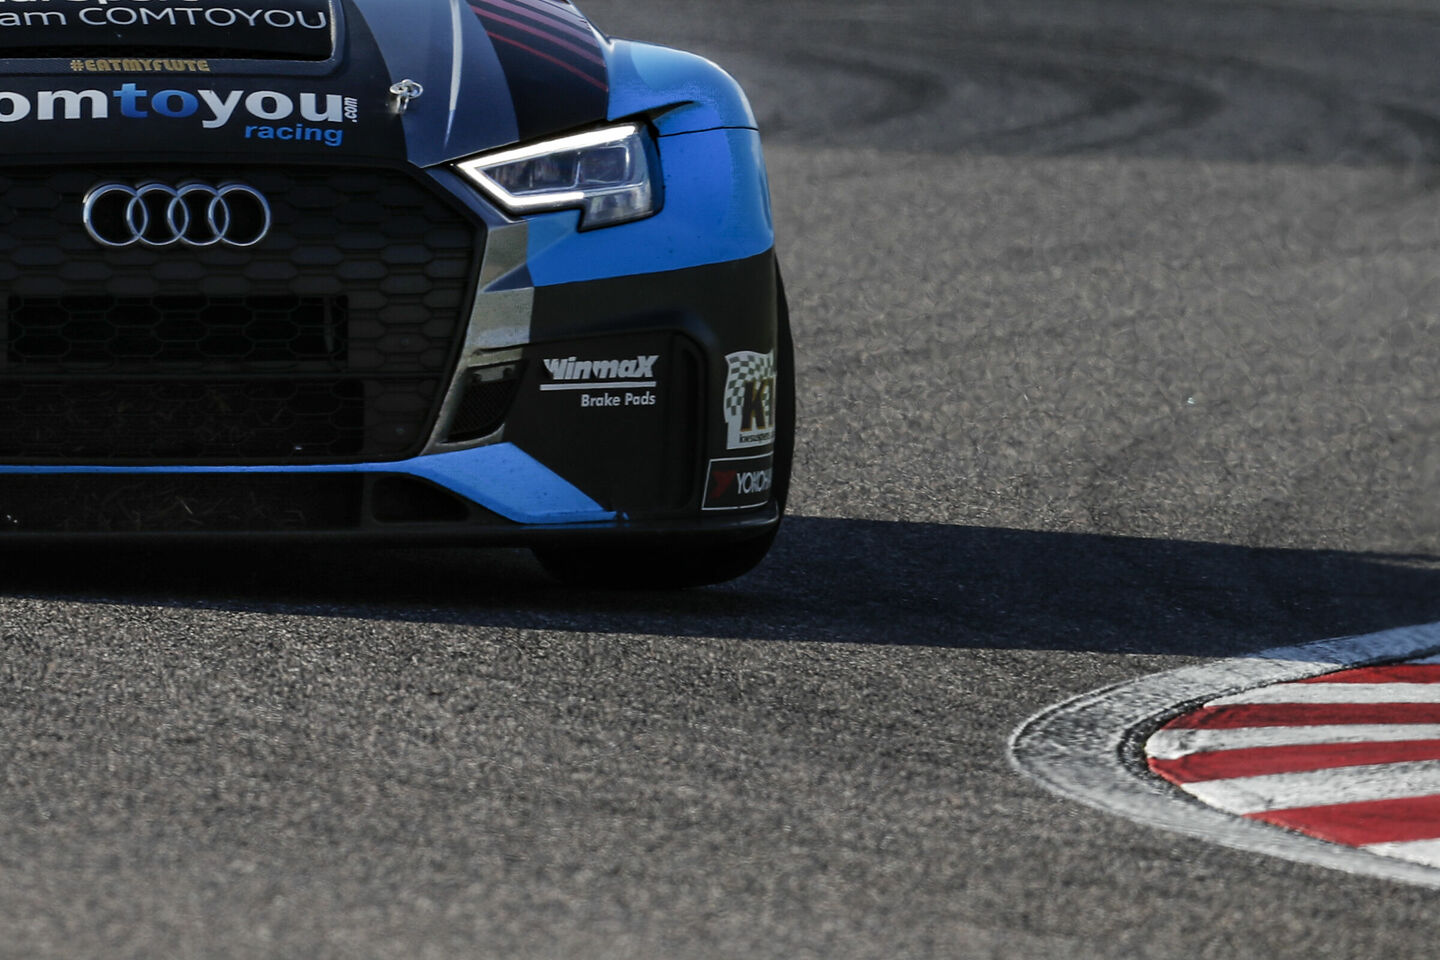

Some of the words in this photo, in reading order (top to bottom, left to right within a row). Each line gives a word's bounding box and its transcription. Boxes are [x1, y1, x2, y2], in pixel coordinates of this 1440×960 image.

[78, 7, 328, 30] COMTOYOU
[343, 96, 358, 124] .com
[244, 122, 344, 147] racing
[580, 393, 621, 407] Brake
[624, 391, 656, 406] Pads
[740, 376, 774, 433] K
